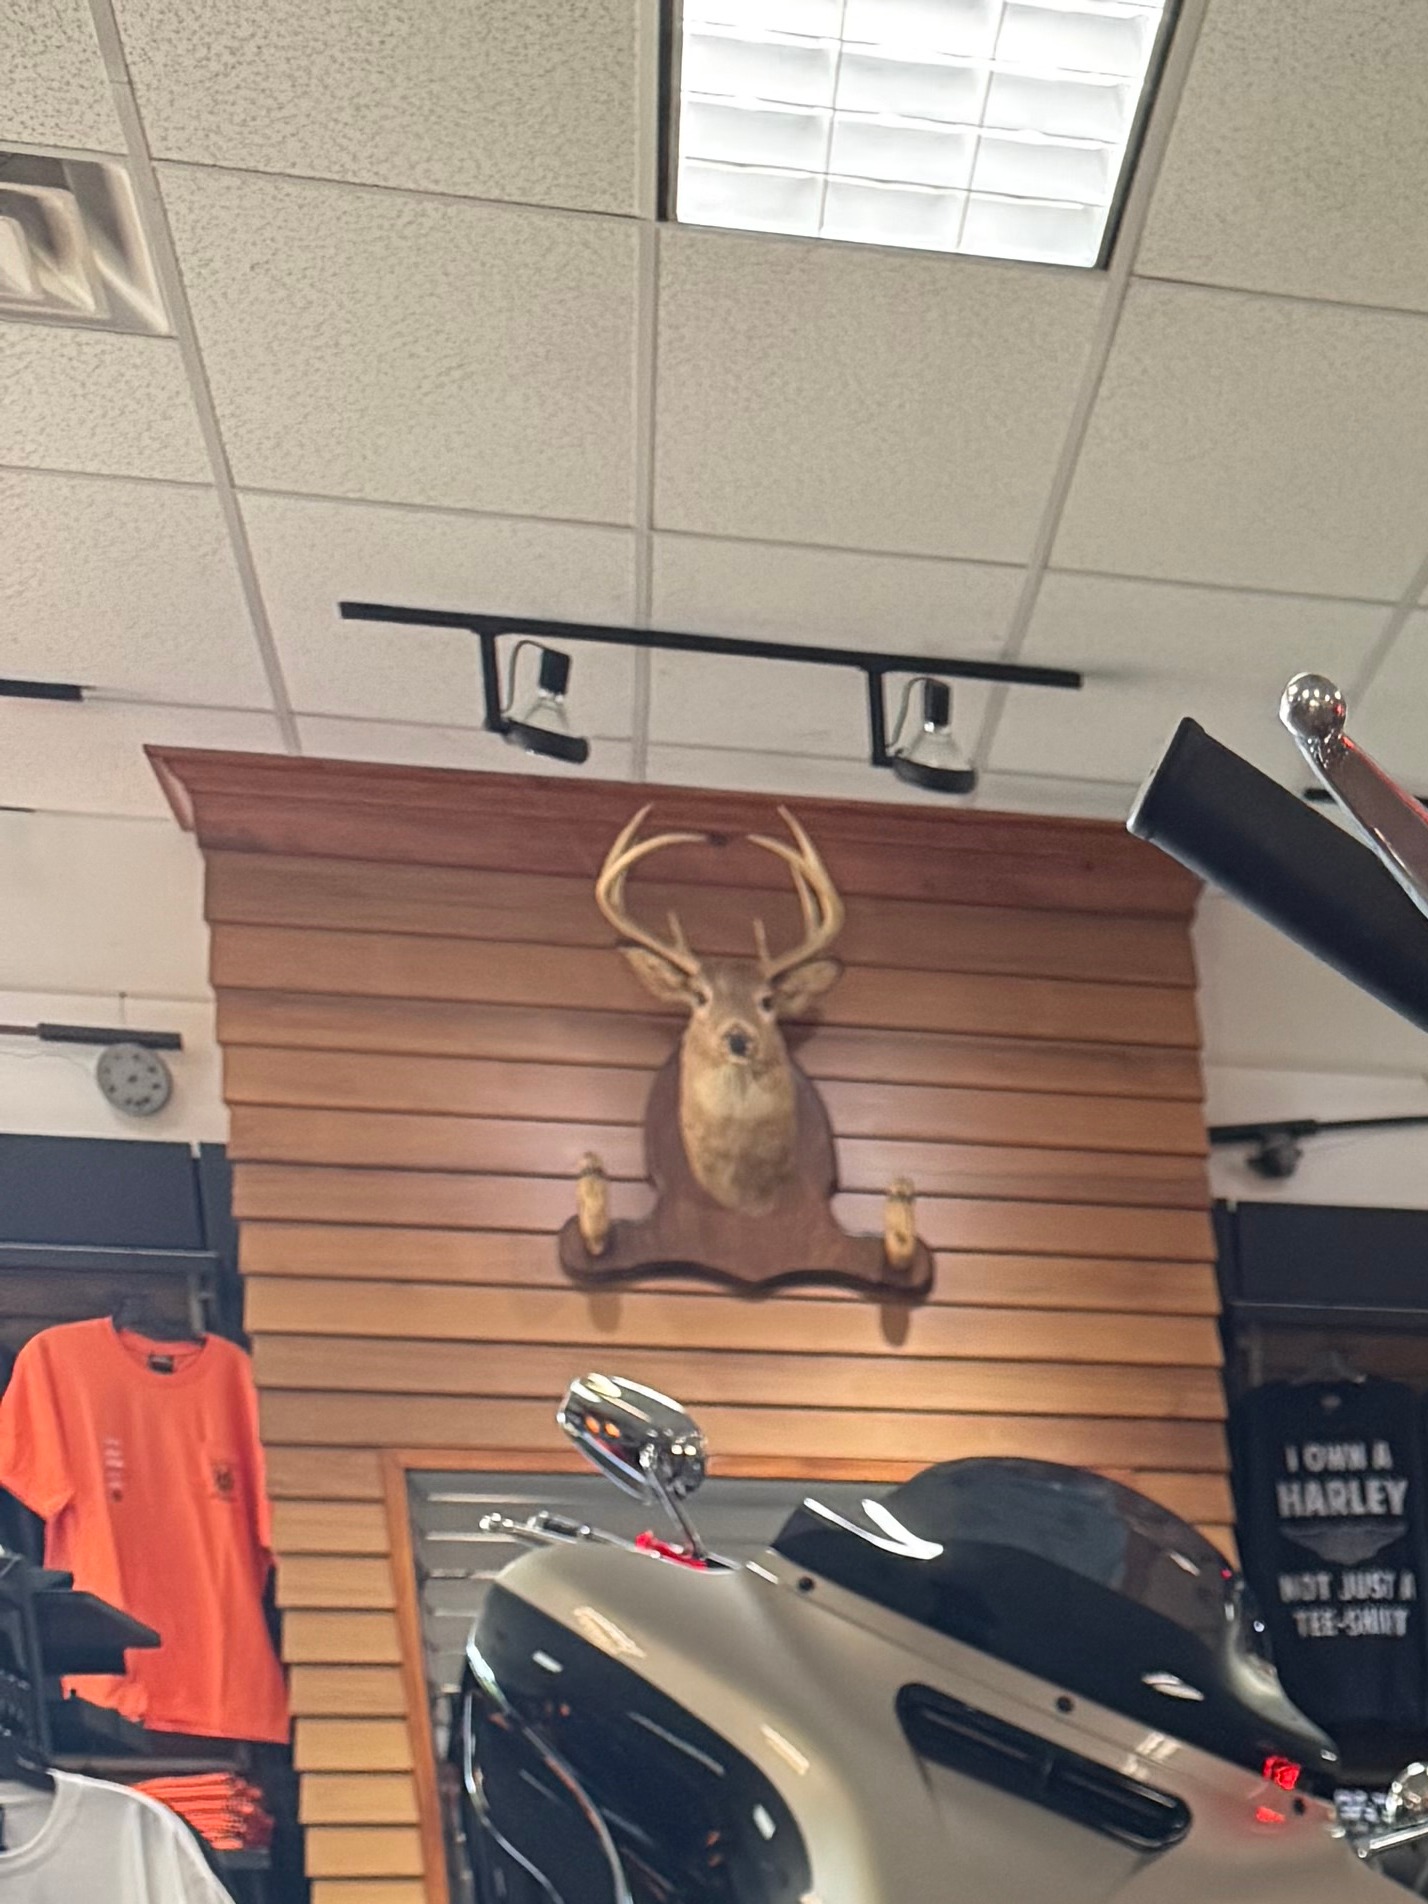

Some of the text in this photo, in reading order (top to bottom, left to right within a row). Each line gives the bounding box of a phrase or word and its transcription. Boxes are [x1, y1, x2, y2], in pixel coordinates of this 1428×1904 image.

[1285, 1440, 1393, 1472] I OWN A
[1276, 1477, 1408, 1518] HARLEY
[1279, 1573, 1331, 1602] NOT
[1340, 1571, 1396, 1600] JUST
